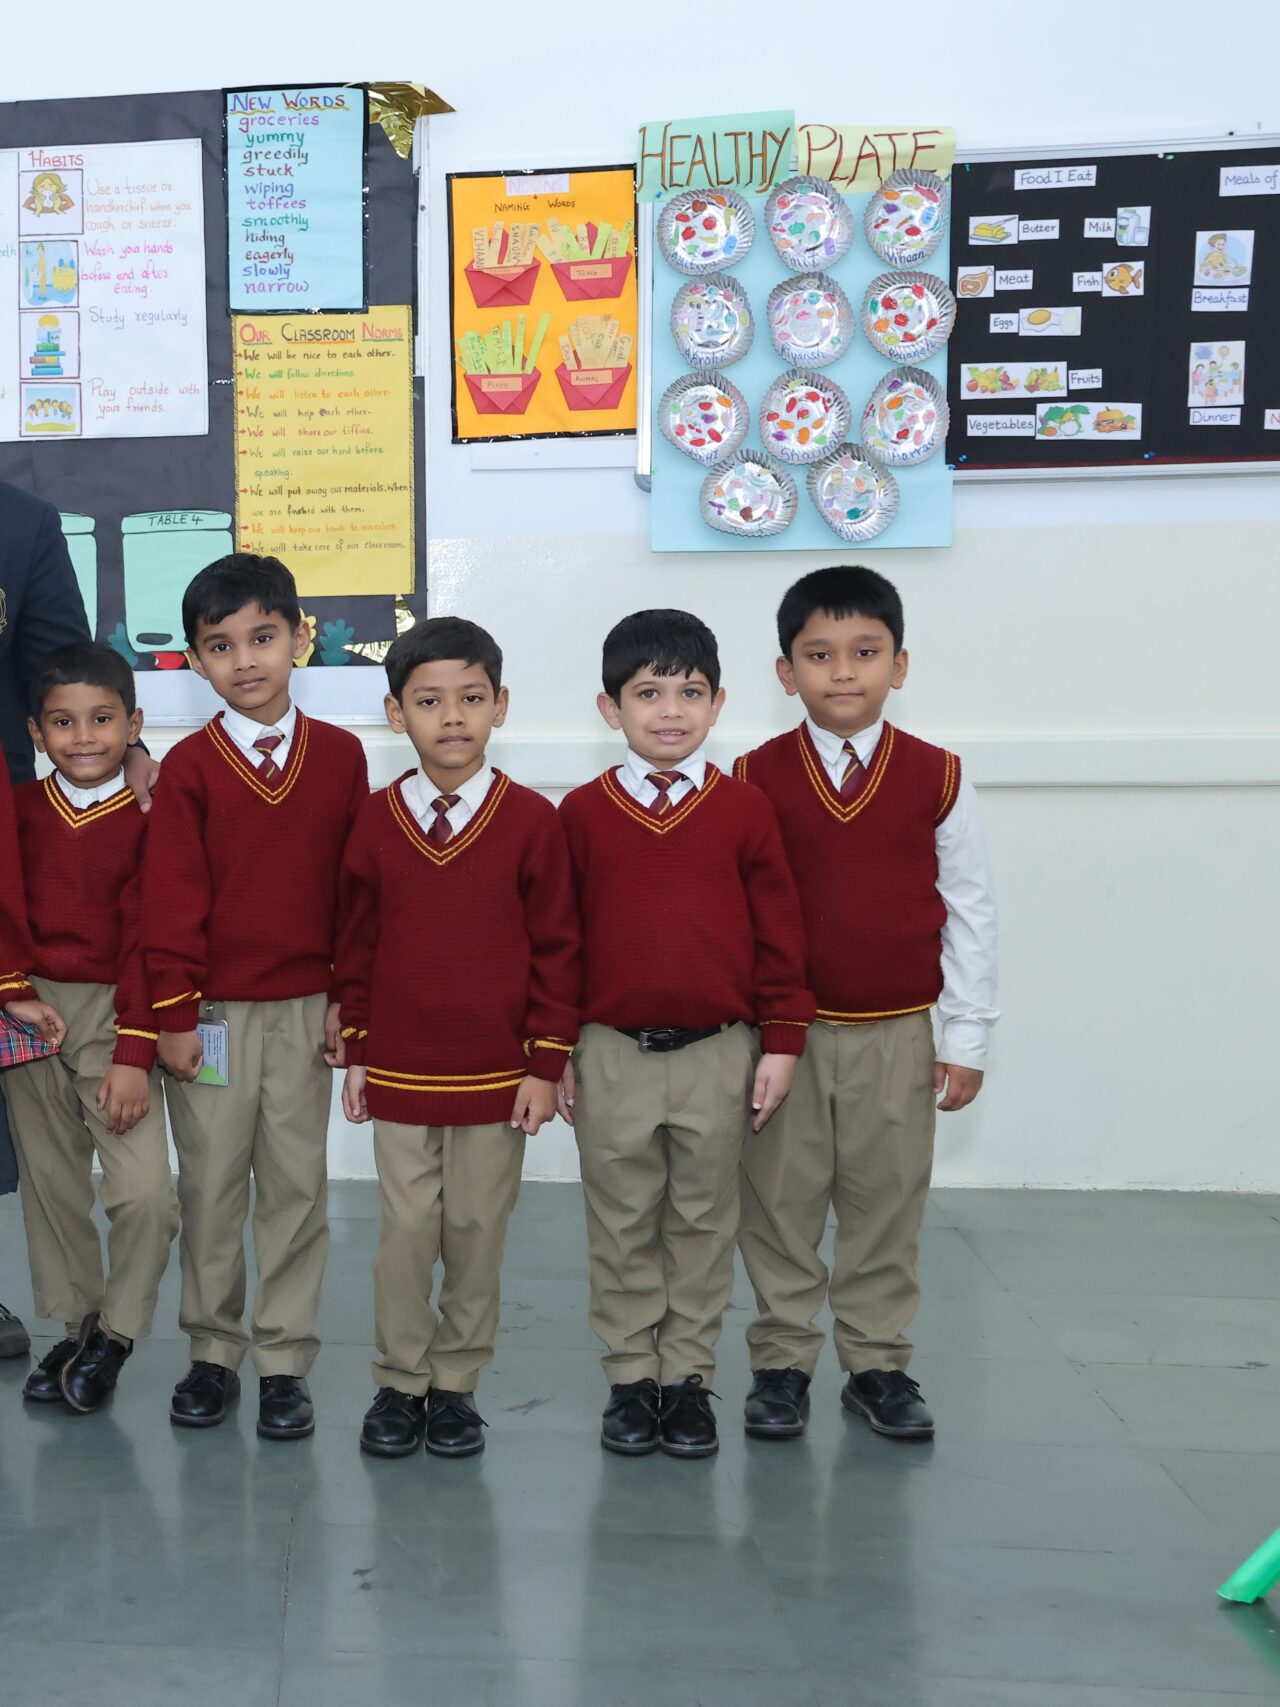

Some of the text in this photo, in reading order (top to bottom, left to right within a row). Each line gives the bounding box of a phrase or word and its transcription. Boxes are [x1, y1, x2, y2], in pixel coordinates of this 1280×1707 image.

[230, 91, 346, 111] NEW WORDS
[239, 113, 319, 132] groceries
[246, 132, 304, 148] yummy
[28, 149, 84, 168] HABITS
[240, 147, 309, 165] greedily
[638, 122, 944, 193] HEALTHY PLATE
[243, 163, 294, 177] stuck
[1021, 169, 1093, 185] Food I Eat
[1225, 169, 1279, 190] Meals of
[245, 182, 294, 199] wiping
[246, 196, 307, 210] toffees
[494, 198, 576, 213] NAMING WORDS
[241, 213, 309, 231] smoothly
[1022, 223, 1056, 233] Butter
[1088, 221, 1113, 232] Milk
[245, 229, 285, 247] hiding
[245, 248, 294, 266] eagerly
[242, 263, 291, 281] slowly
[999, 273, 1031, 285] Meat
[244, 280, 309, 294] narrow
[1077, 275, 1100, 286] Fish
[1193, 290, 1247, 309] Breakfast
[89, 306, 188, 329] Study regularly
[993, 318, 1014, 329] Eggs
[240, 321, 403, 343] OUR CLASSROOM NORMS
[244, 350, 260, 361] We
[267, 350, 282, 360] will
[286, 350, 296, 360] be
[302, 350, 321, 360] nice
[327, 350, 337, 360] to
[343, 349, 362, 358] each
[1071, 372, 1101, 385] Fruits
[129, 382, 169, 396] outside
[178, 383, 200, 395] with
[1192, 411, 1236, 423] Dinner
[969, 419, 1034, 434] Vegetables
[287, 487, 301, 499] put
[148, 514, 204, 527] TABLE 4
